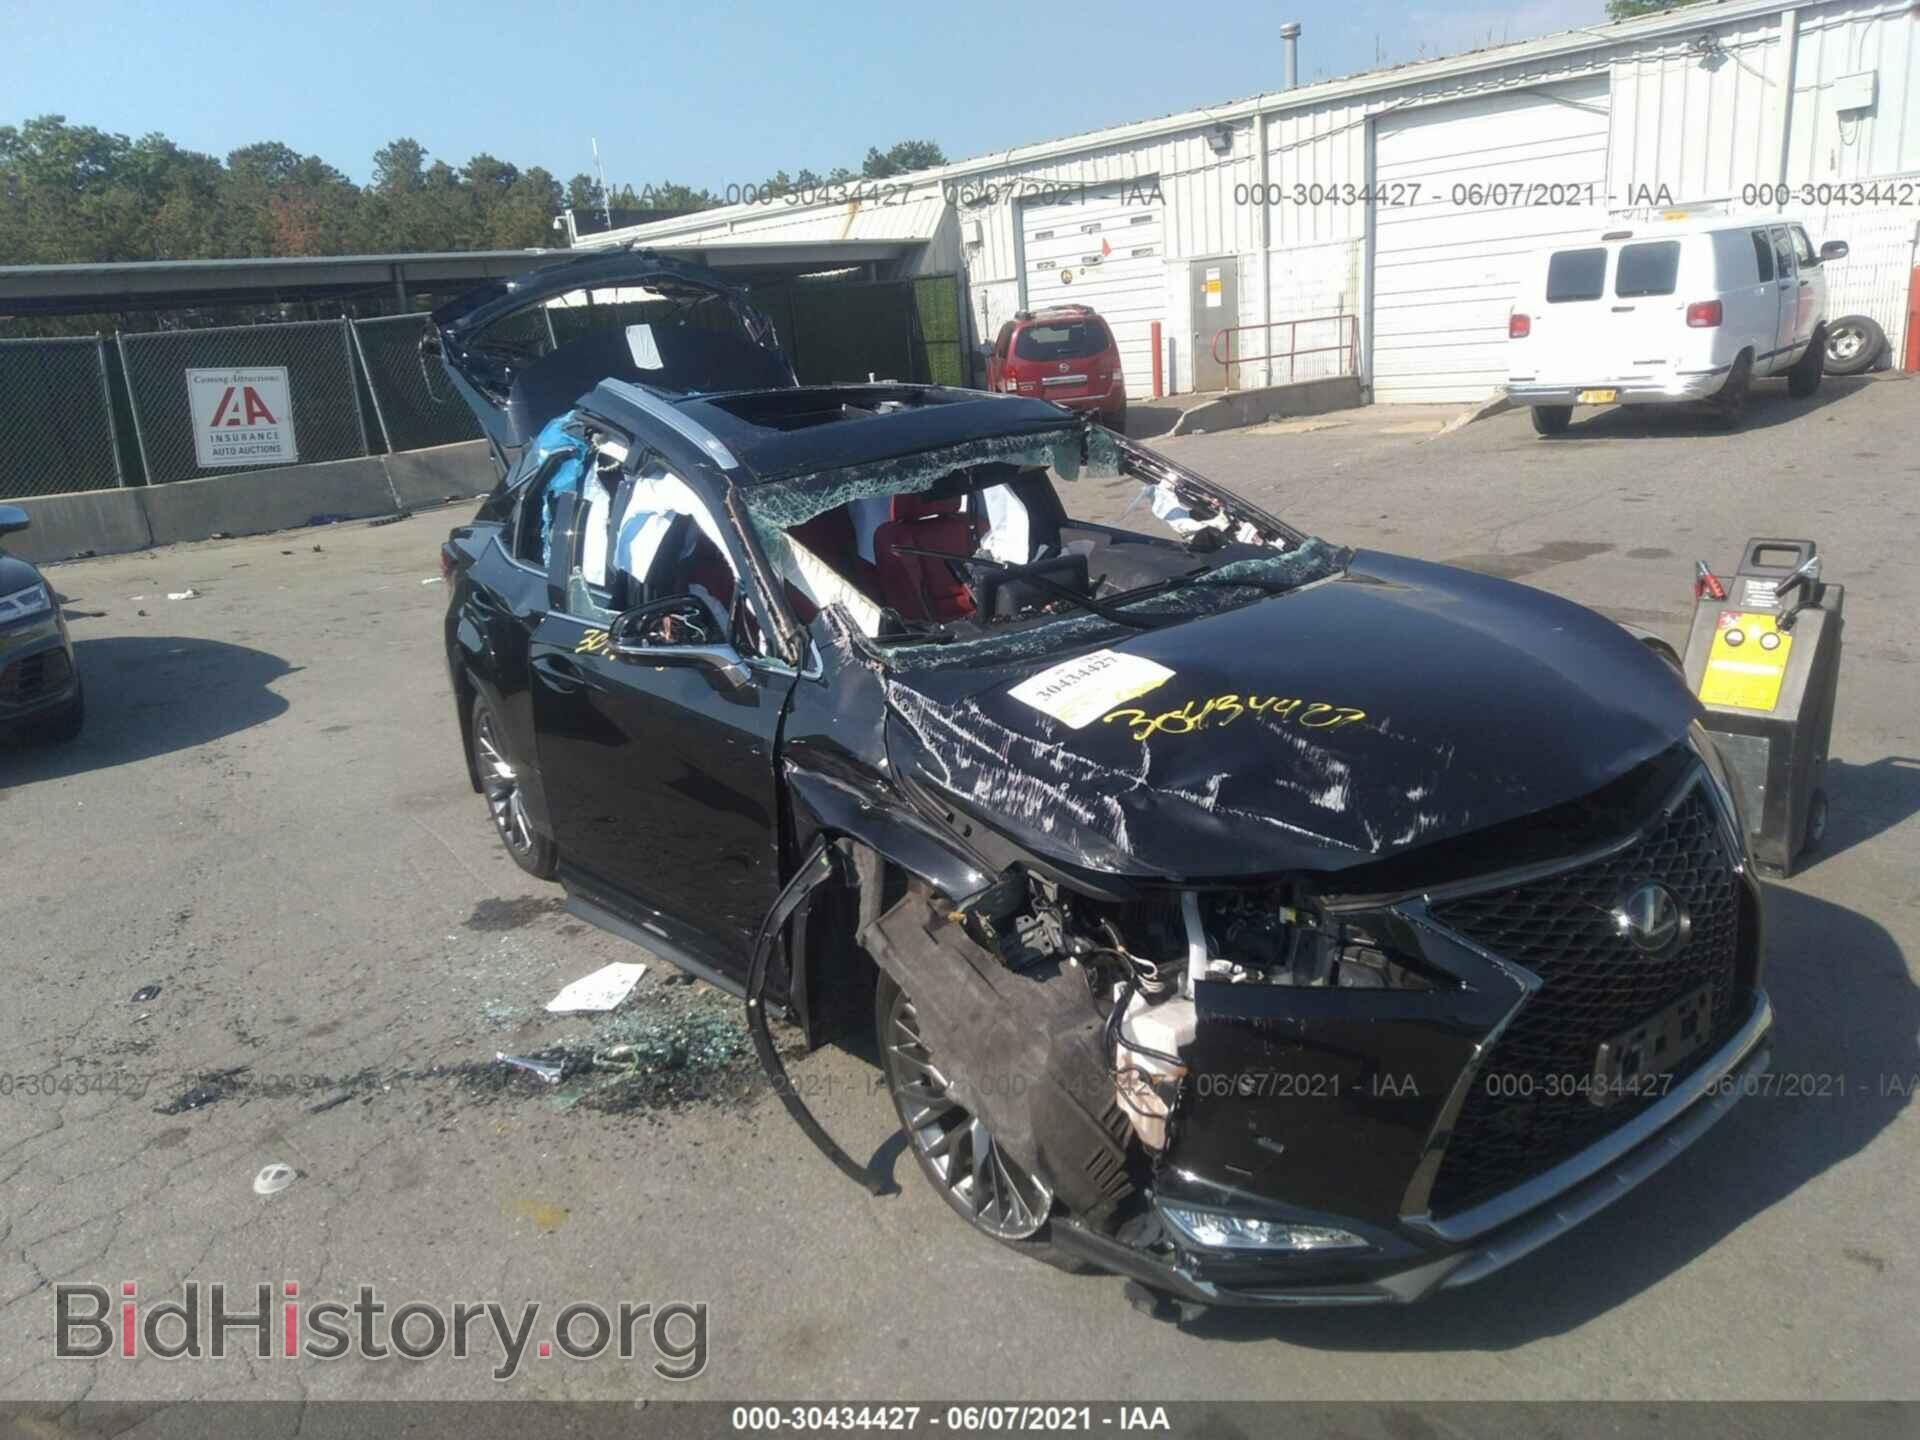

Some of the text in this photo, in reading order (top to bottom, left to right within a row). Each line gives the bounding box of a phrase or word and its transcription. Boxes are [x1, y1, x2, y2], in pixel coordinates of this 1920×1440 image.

[210, 431, 280, 443] INSURANCE
[212, 444, 282, 456] AUTO AUCTIONS
[1035, 656, 1119, 702] 30434427
